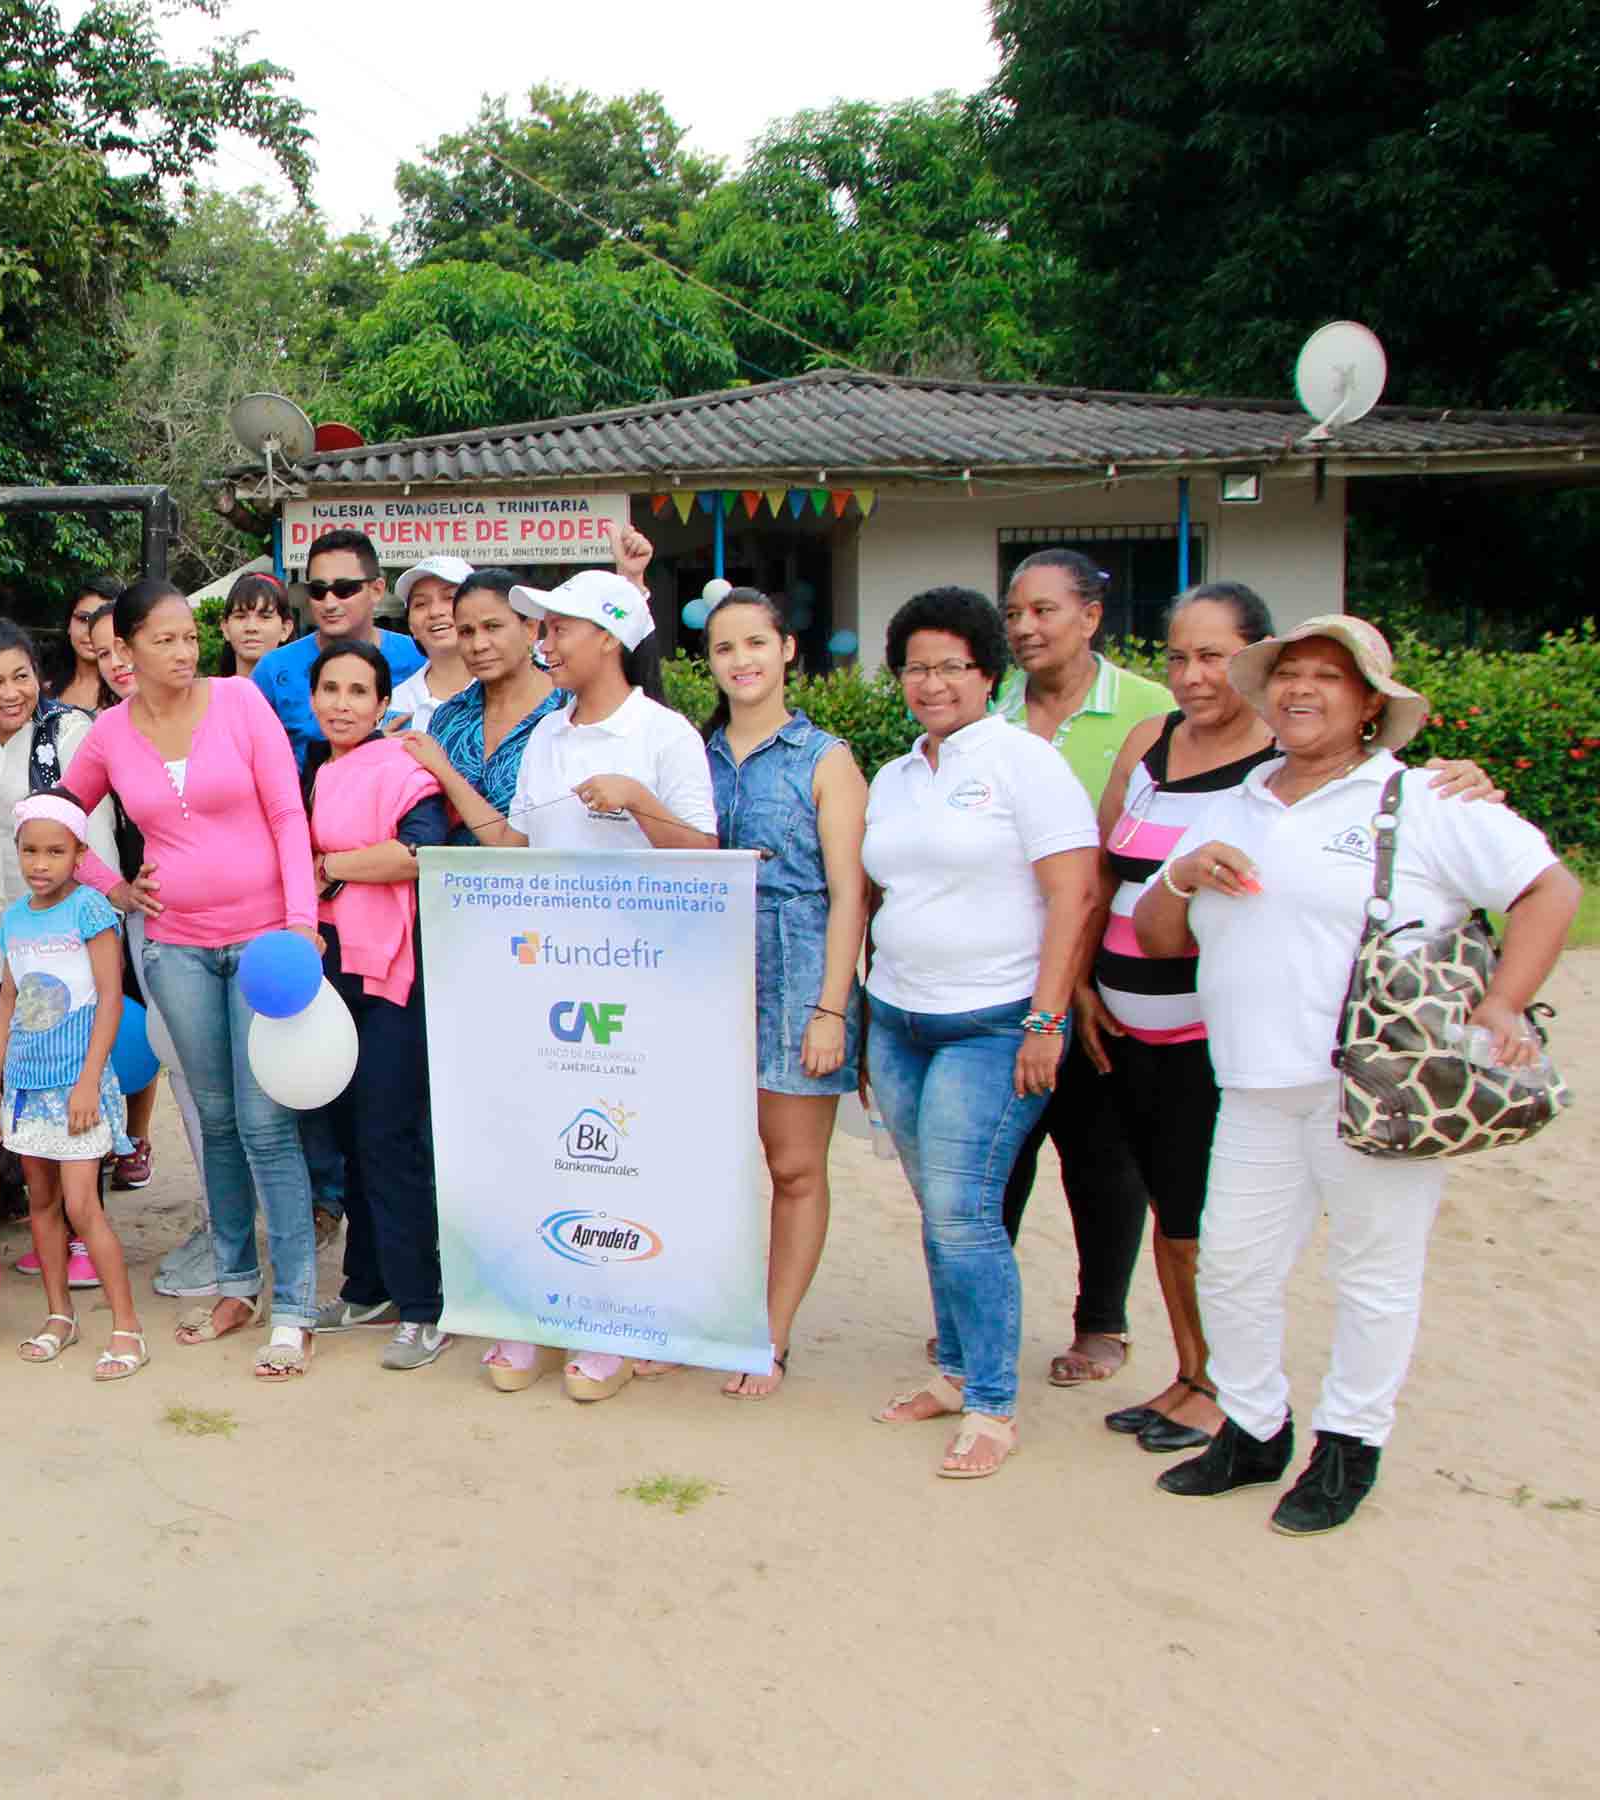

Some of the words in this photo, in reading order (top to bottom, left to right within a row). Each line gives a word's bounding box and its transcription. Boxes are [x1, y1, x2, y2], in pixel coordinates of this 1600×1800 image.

[312, 503, 375, 519] IGLESIA
[385, 501, 486, 516] EVANGELICA
[496, 499, 590, 513] TRINITARIA
[291, 521, 356, 545] DI
[363, 520, 467, 543] FUENTE
[475, 518, 509, 542] DE
[519, 517, 613, 541] PODER
[384, 549, 425, 561] ESPECIAL
[444, 871, 524, 892] Programa
[529, 873, 550, 890] de
[555, 873, 632, 892] inclusión
[638, 874, 729, 895] financiera
[451, 892, 461, 908] y
[466, 890, 612, 910] empoderamiento
[617, 894, 727, 913] comunitario
[541, 935, 664, 969] fundefir
[576, 1124, 608, 1152] Bk
[553, 1157, 640, 1177] Bankomunales
[571, 1224, 640, 1252] Aprodefa
[535, 1313, 669, 1346] www.fundefir.org
